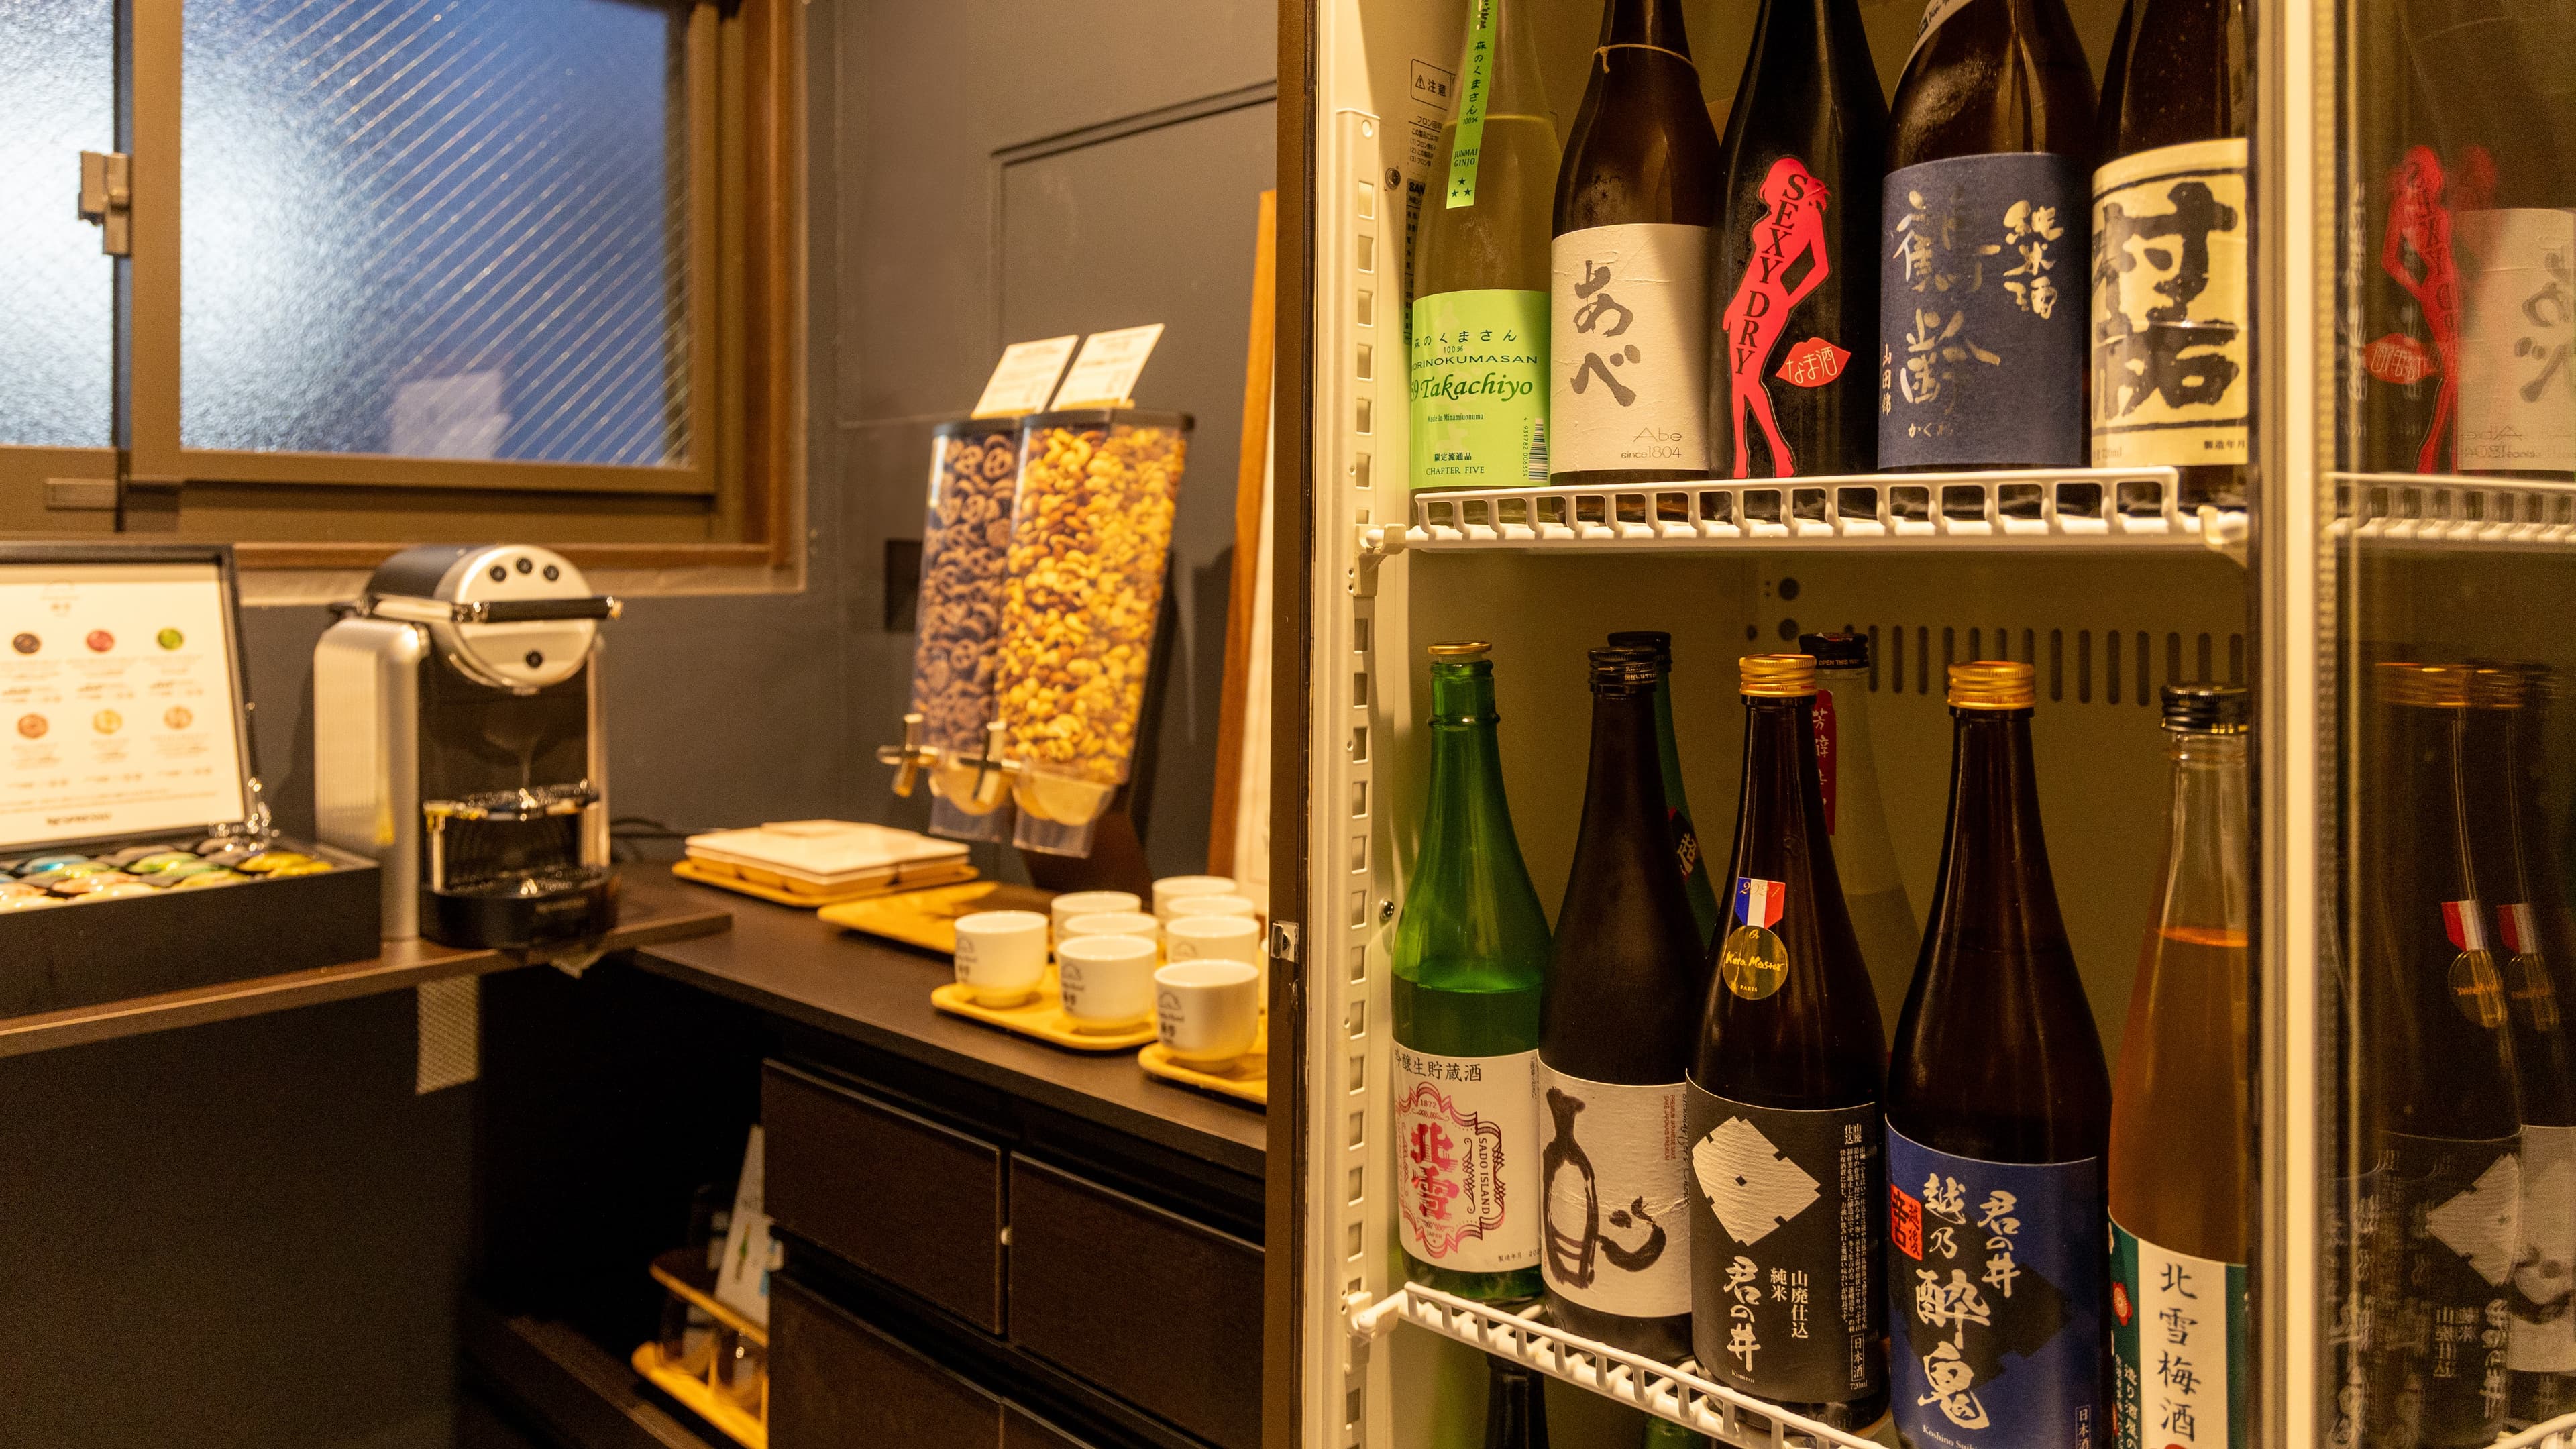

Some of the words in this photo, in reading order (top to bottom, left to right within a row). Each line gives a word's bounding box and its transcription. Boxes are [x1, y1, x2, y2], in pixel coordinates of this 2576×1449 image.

[1428, 78, 1446, 97] 注意
[1466, 41, 1487, 115] 森のくまさん
[1463, 117, 1478, 125] 100%
[1454, 148, 1477, 160] JUNMAI
[1454, 158, 1476, 168] GINJO
[1760, 174, 1809, 284] SEXY
[2004, 201, 2063, 319] 純米酒
[1414, 329, 1517, 349] 森のくまさん
[1570, 260, 1641, 407] あべ
[1735, 290, 1770, 375] DRY
[1410, 355, 1538, 370] ORINOKUMASAN
[1786, 345, 1838, 384] なま酒
[1882, 343, 1892, 416] 山田錦
[1428, 415, 1438, 423] Made
[1444, 413, 1484, 421] Minamiuonuma
[1633, 427, 1682, 442] Abe
[1426, 467, 1460, 476] CHAPTER
[1434, 452, 1472, 462] 限定流通品
[1739, 882, 1780, 898] 2021
[1748, 956, 1785, 971] Master
[1420, 1099, 1438, 1108] 1872
[1411, 1122, 1460, 1220] 北雪
[1479, 1138, 1487, 1169] SADO
[1479, 1171, 1490, 1214] ISLAND
[1892, 1191, 1909, 1248] 辛口
[1977, 1190, 2021, 1297] 君の井
[1770, 1267, 1788, 1302] 純米
[1723, 1256, 1761, 1372] 君の井
[1791, 1270, 1809, 1338] 山廃仕込
[1854, 1337, 1863, 1378] 日本酒
[2157, 1263, 2201, 1442] 北雪梅酒
[1923, 1424, 1954, 1446] Koshino
[1955, 1440, 1978, 1449] Suik
